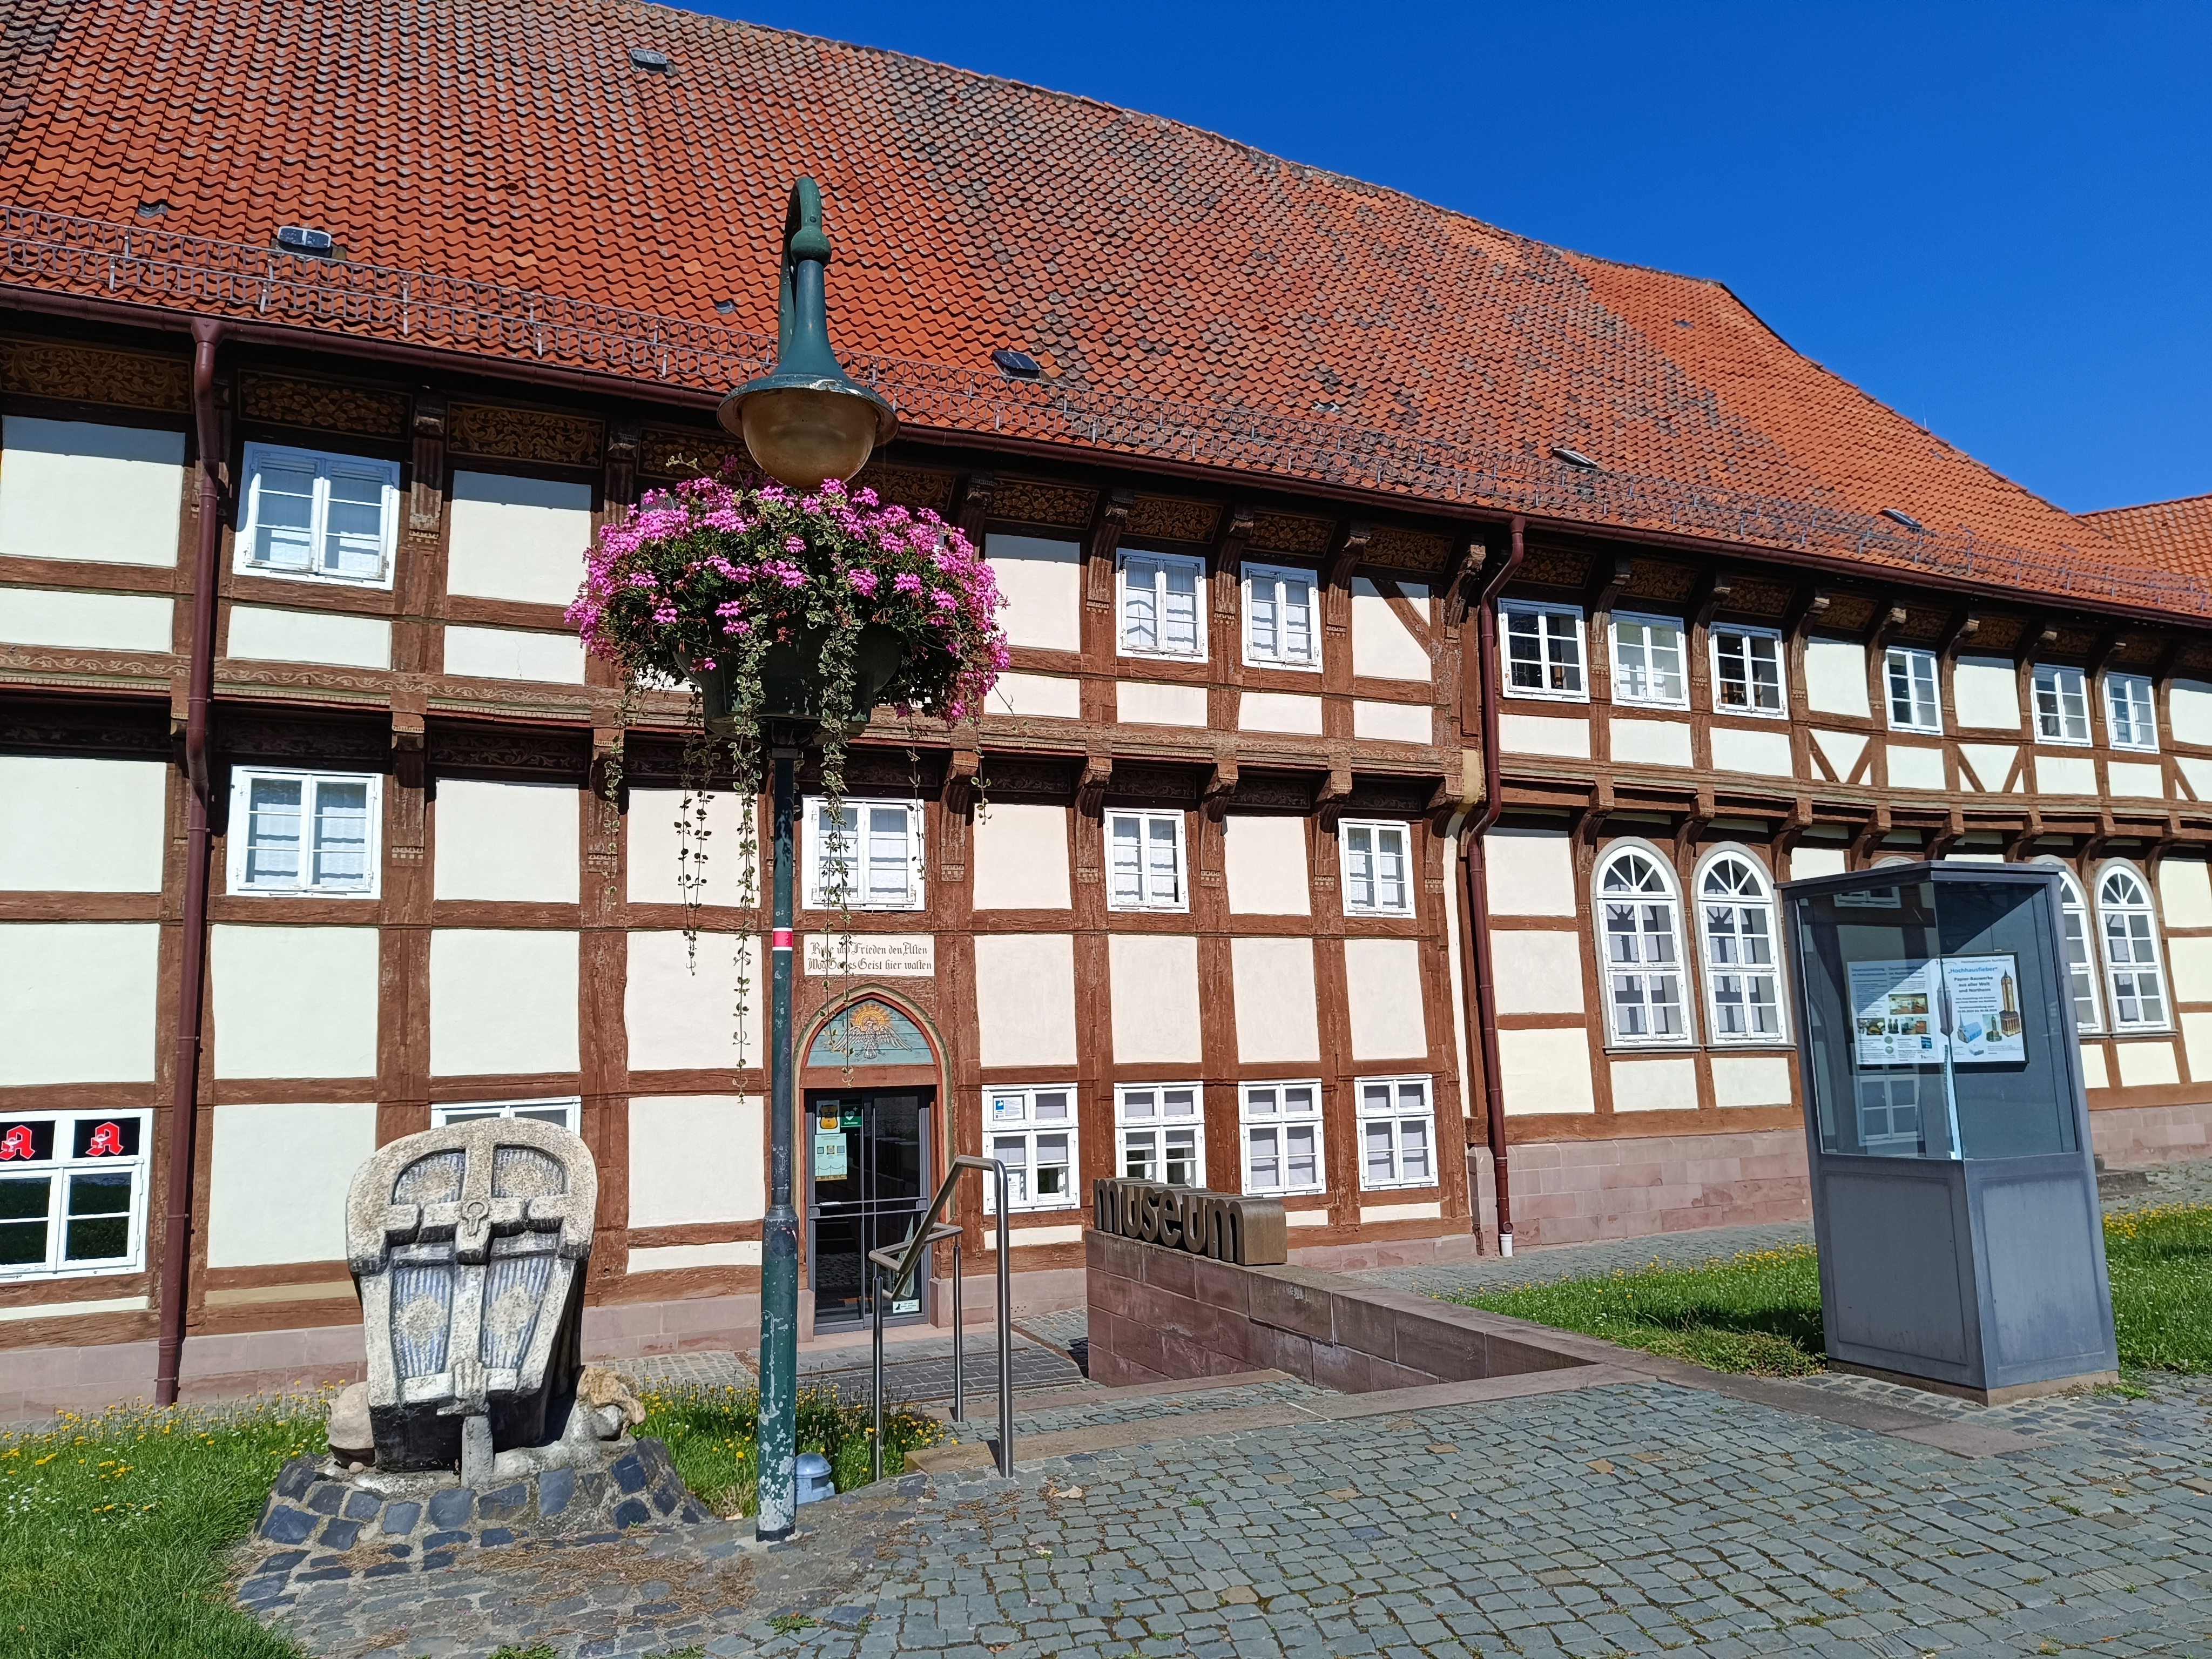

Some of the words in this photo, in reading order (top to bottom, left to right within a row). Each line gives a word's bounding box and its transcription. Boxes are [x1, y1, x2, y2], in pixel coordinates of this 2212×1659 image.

[837, 945, 850, 954] und
[851, 942, 886, 955] Frieden
[888, 945, 902, 954] den
[858, 957, 882, 969] Geist
[885, 959, 902, 971] hier
[1093, 1177, 1246, 1265] museum
